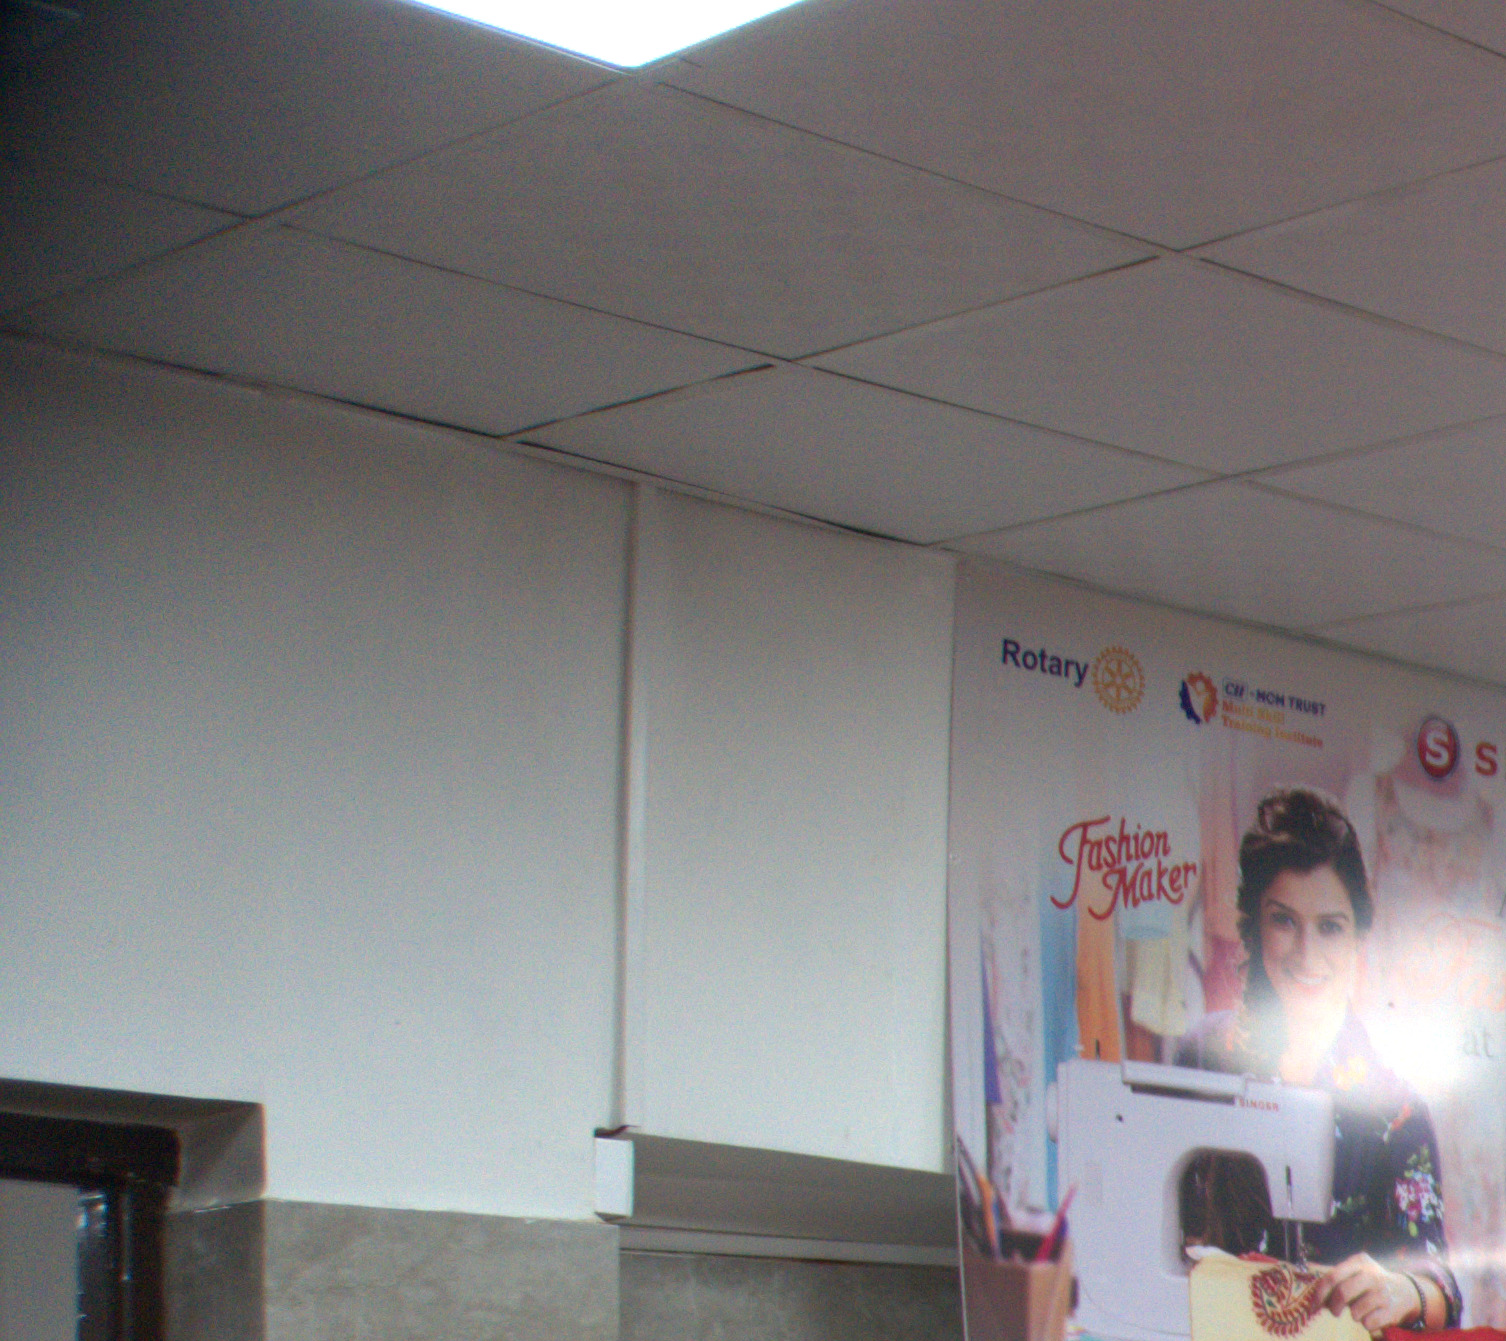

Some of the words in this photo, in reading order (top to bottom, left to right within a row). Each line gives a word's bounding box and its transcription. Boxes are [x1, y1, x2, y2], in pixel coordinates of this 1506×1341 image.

[1002, 638, 1089, 688] Rotary
[1288, 695, 1326, 716] TRUST
[1050, 815, 1171, 910] Fashion
[1087, 860, 1197, 921] Maker
[1461, 1024, 1493, 1059] at
